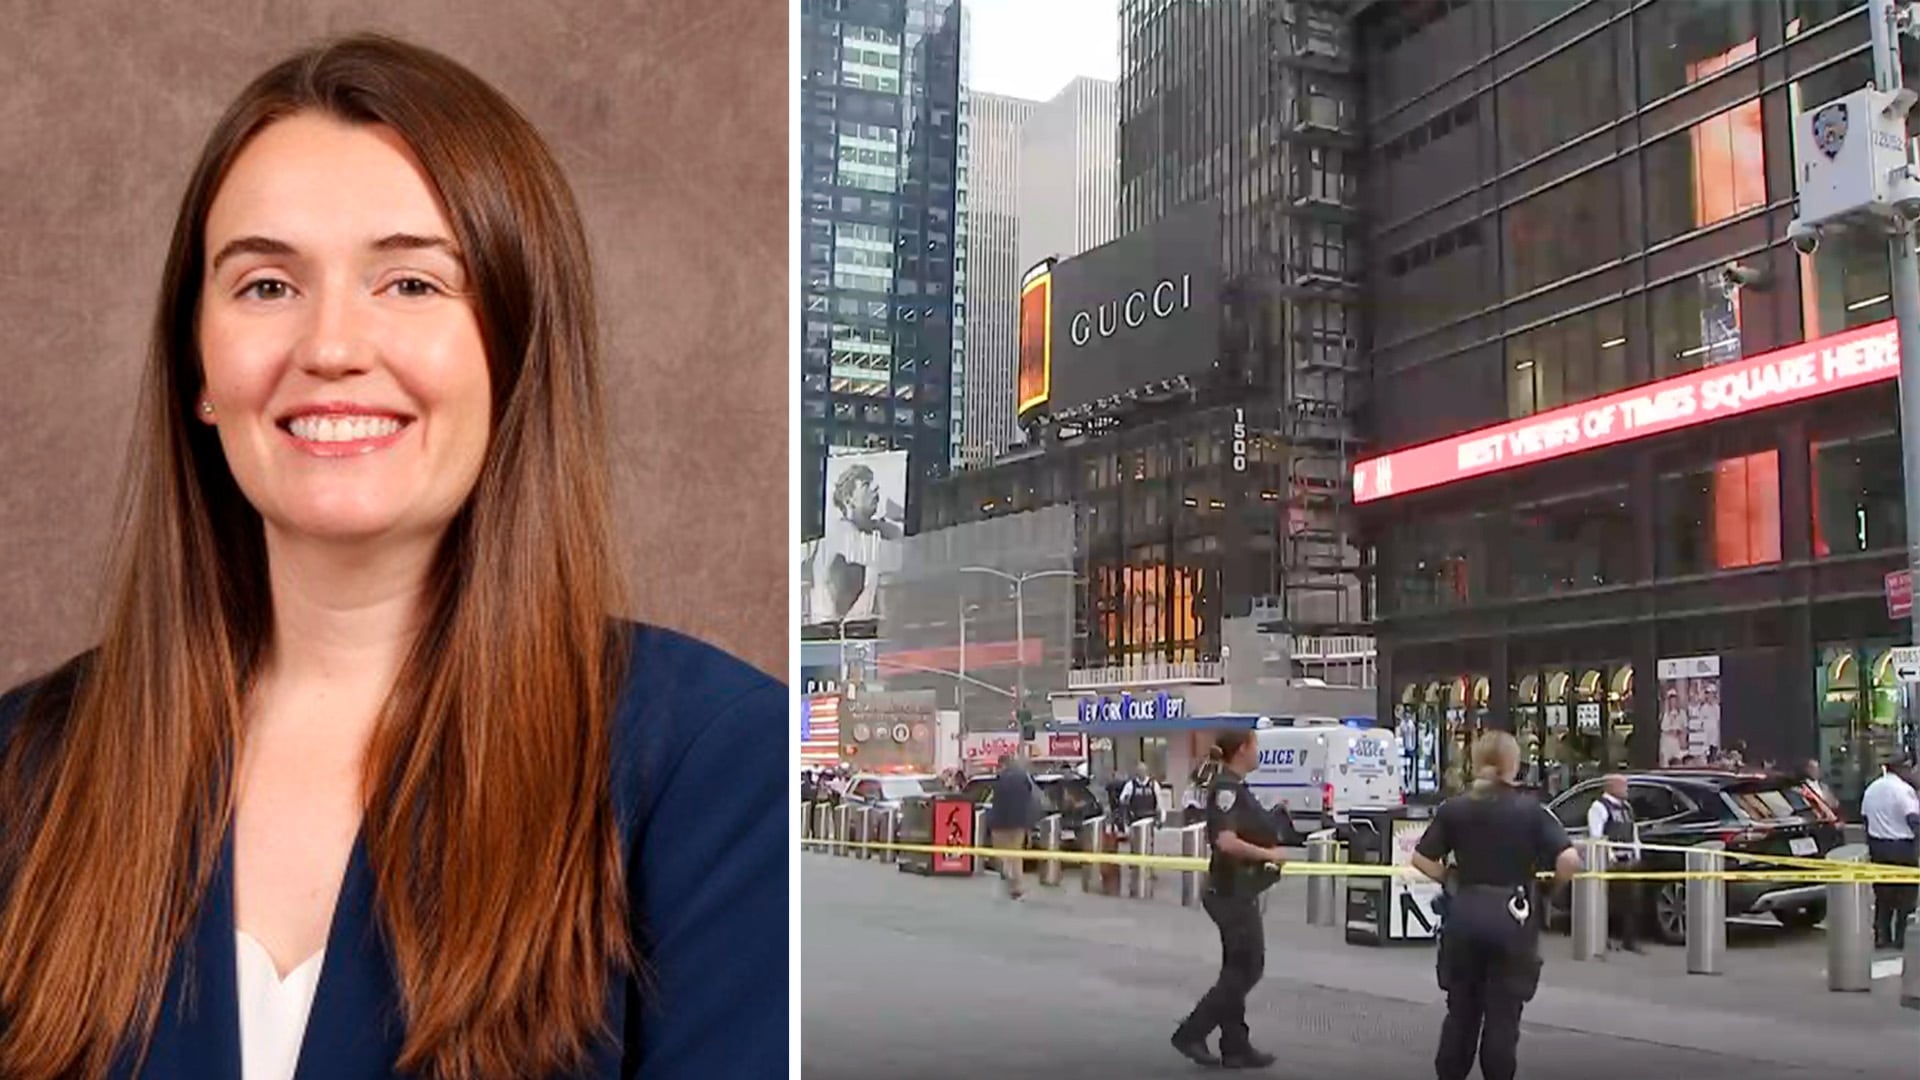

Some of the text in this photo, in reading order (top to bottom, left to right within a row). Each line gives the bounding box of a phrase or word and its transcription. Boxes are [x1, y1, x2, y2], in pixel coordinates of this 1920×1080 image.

[1070, 273, 1192, 346] GUCCI
[1509, 416, 1580, 456] VIEWS
[1583, 405, 1617, 438] OF
[1620, 385, 1696, 430] TIMES
[1701, 352, 1817, 410] SQUARE
[1822, 332, 1900, 381] HERE
[1233, 408, 1246, 471] 1500
[1258, 749, 1296, 766] OLICE
